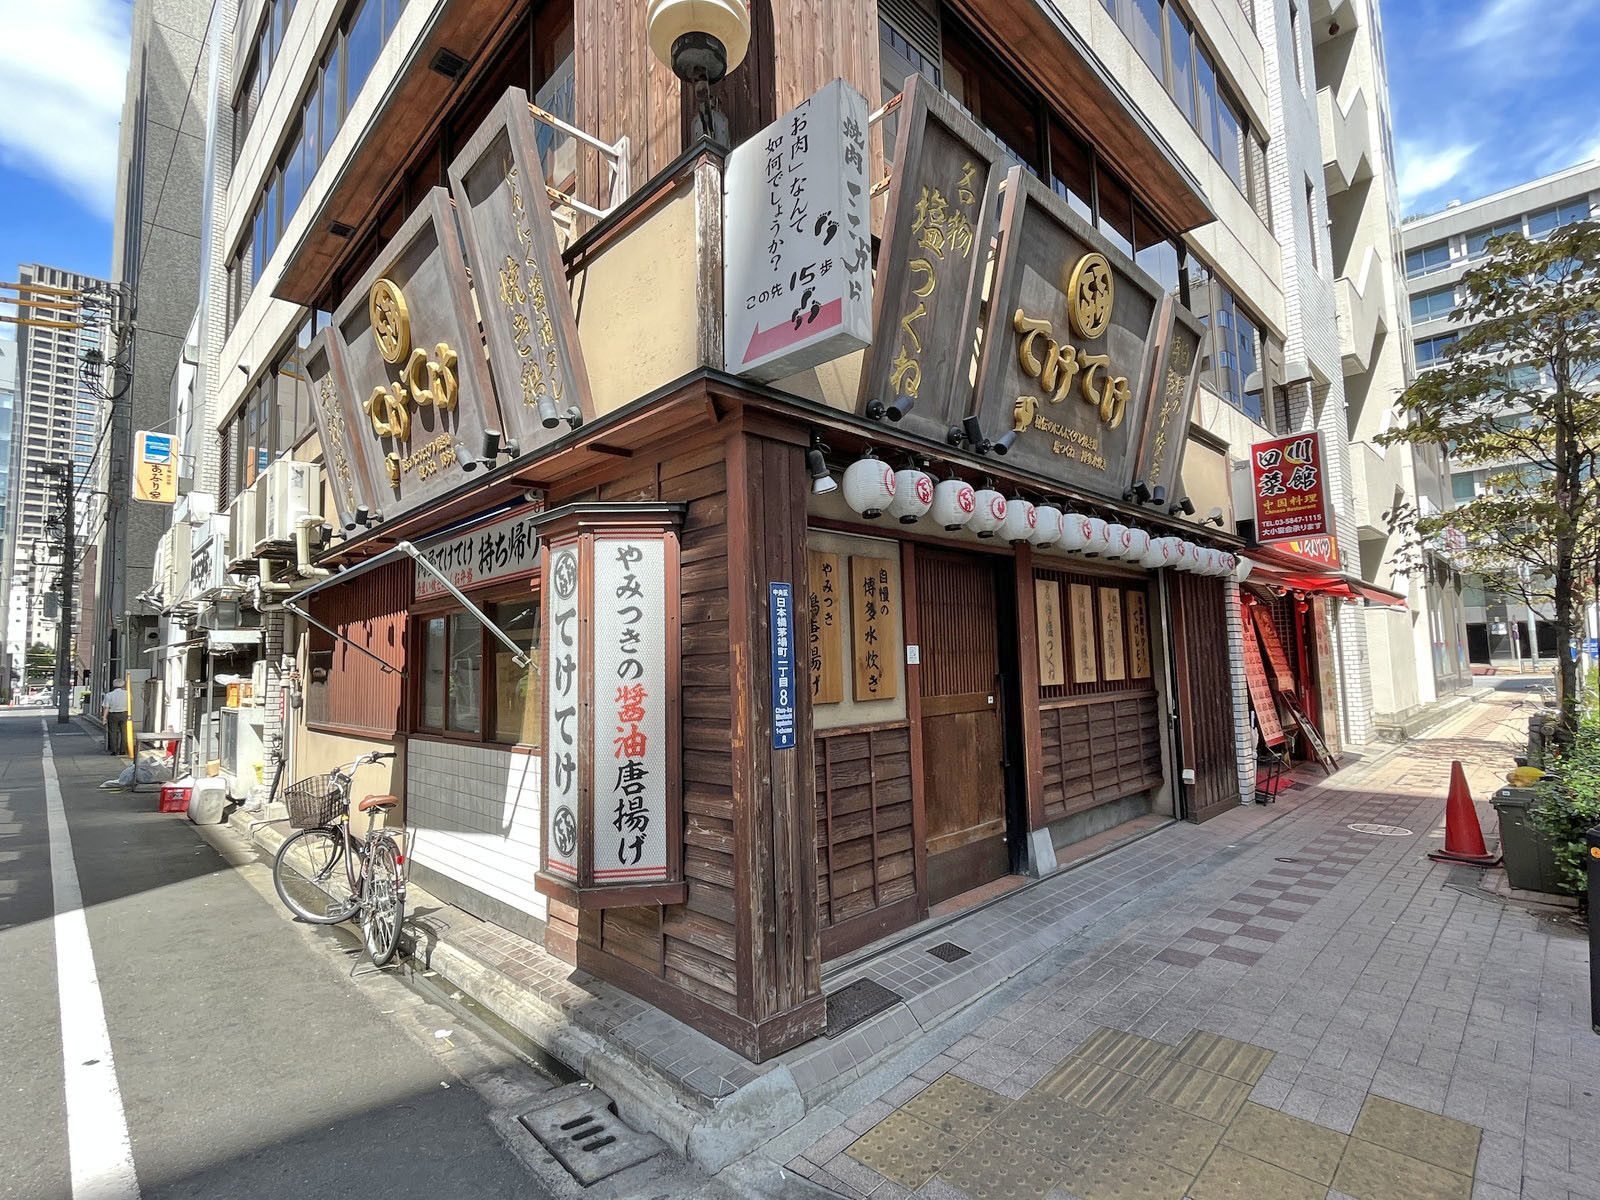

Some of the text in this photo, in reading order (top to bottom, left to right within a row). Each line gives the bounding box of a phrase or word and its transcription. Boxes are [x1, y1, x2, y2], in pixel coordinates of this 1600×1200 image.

[947, 161, 977, 258] 名物
[889, 185, 949, 399] 塩つくね
[1263, 494, 1318, 509] 中国料理
[821, 562, 834, 626] やみつき
[863, 577, 880, 693] 博多水炊き
[879, 568, 890, 616] 自慢の
[554, 607, 577, 796] てけてけ
[612, 544, 649, 866] やみつきの醤油唐揚げ
